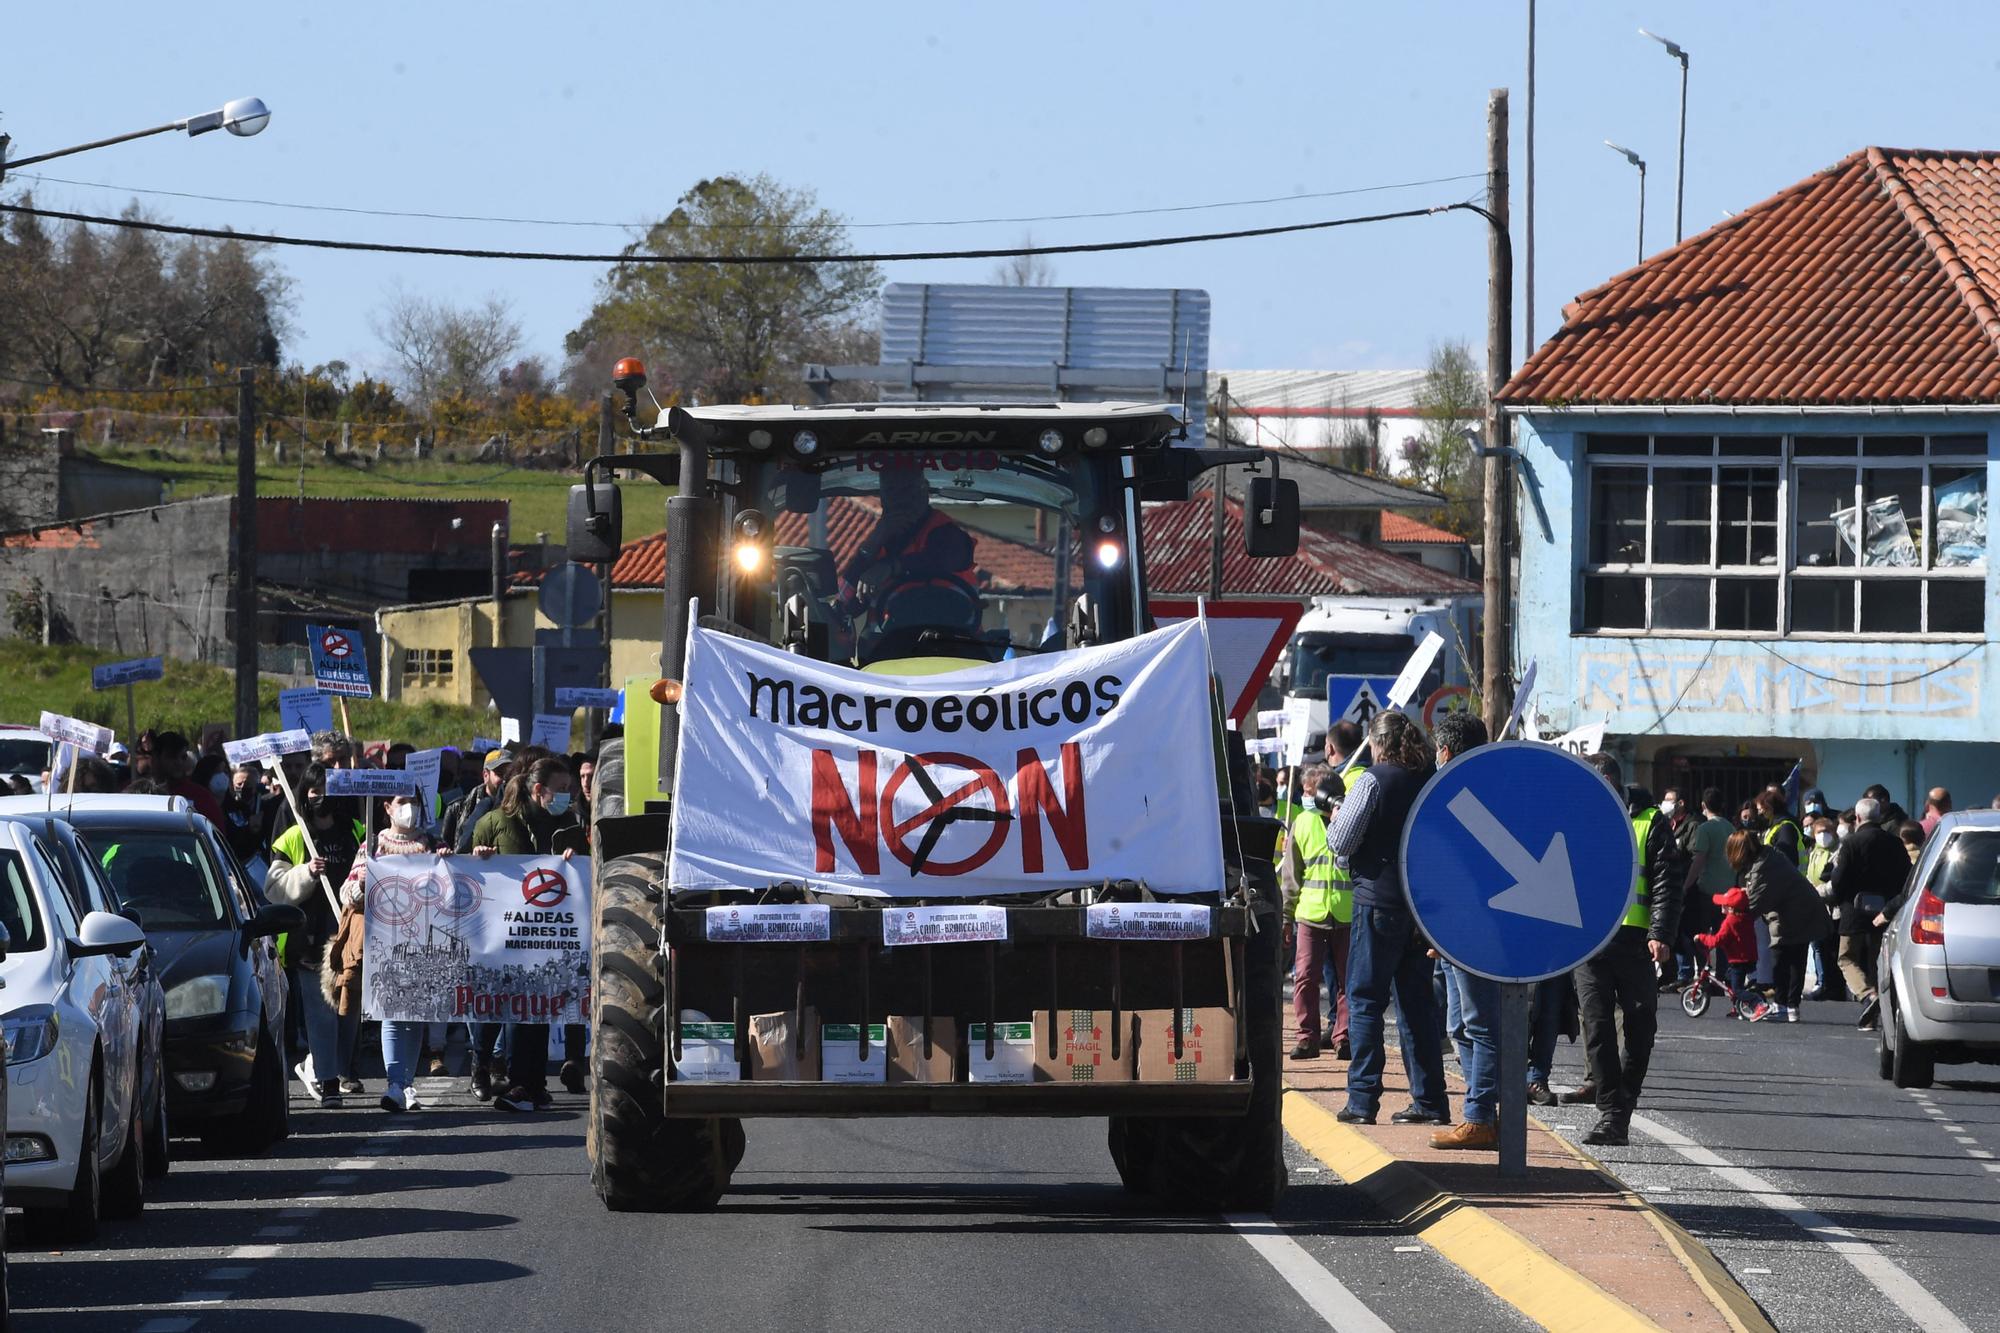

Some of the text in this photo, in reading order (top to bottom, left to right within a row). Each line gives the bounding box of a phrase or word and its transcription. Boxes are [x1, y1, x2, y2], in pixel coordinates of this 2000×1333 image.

[856, 431, 996, 444] ARION
[856, 450, 999, 472] IGNACIO
[320, 660, 360, 671] ALDEAS
[318, 670, 365, 682] LIBRES DE
[1584, 659, 1973, 711] RECAMBIOS
[746, 673, 1123, 733] macroeólicos
[811, 742, 1089, 876] NON
[503, 911, 575, 924] #ALDEAS
[508, 926, 579, 938] LIBRES DE
[452, 984, 567, 1022] Porque
[1065, 1041, 1102, 1052] FRAGIL
[1166, 1039, 1203, 1050] FAGIL
